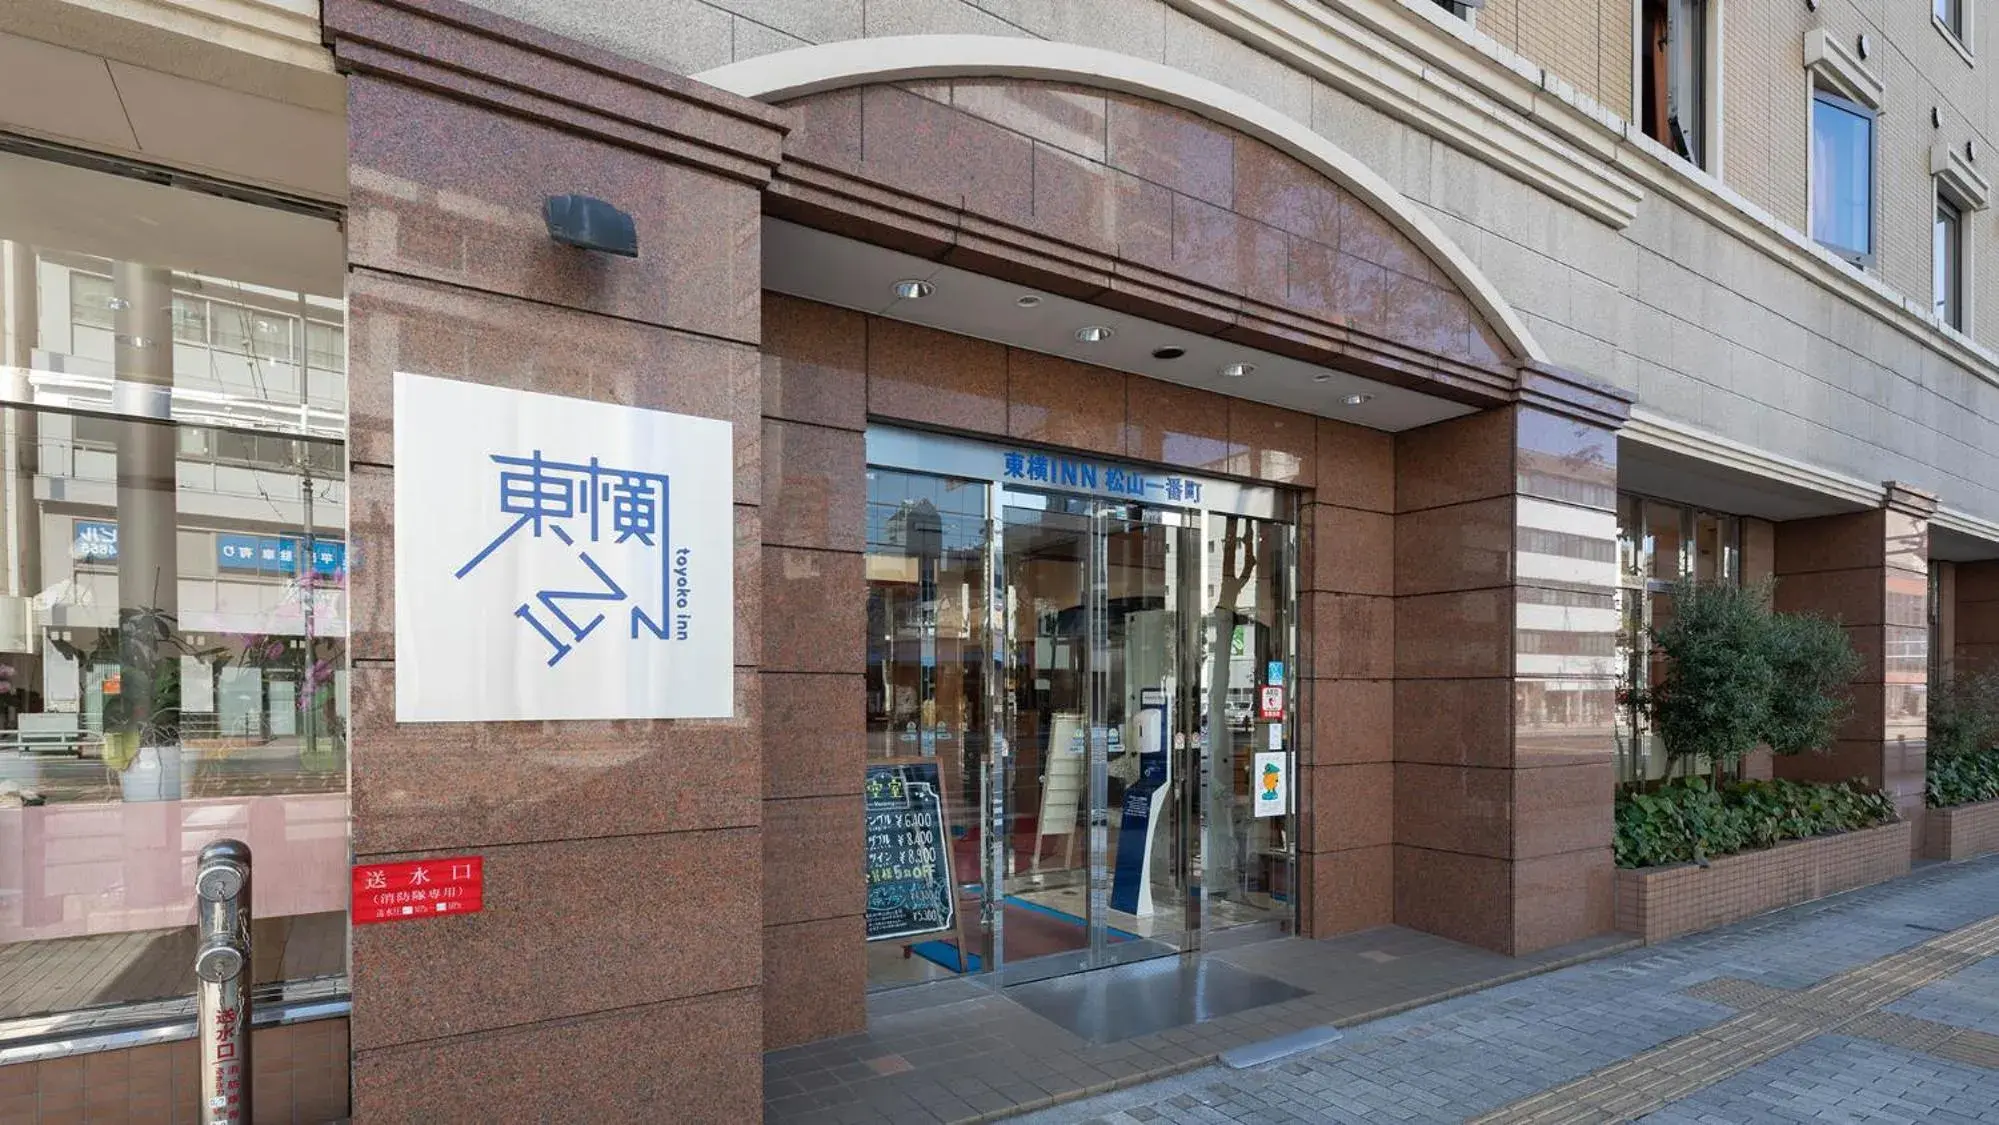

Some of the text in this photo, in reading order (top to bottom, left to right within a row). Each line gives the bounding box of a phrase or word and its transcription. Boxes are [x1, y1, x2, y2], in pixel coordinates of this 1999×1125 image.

[1003, 451, 1203, 504] 東横INN 松山一番町
[673, 547, 691, 642] toyoko inn
[364, 863, 472, 890] 送水口
[215, 1008, 236, 1060] 送水口
